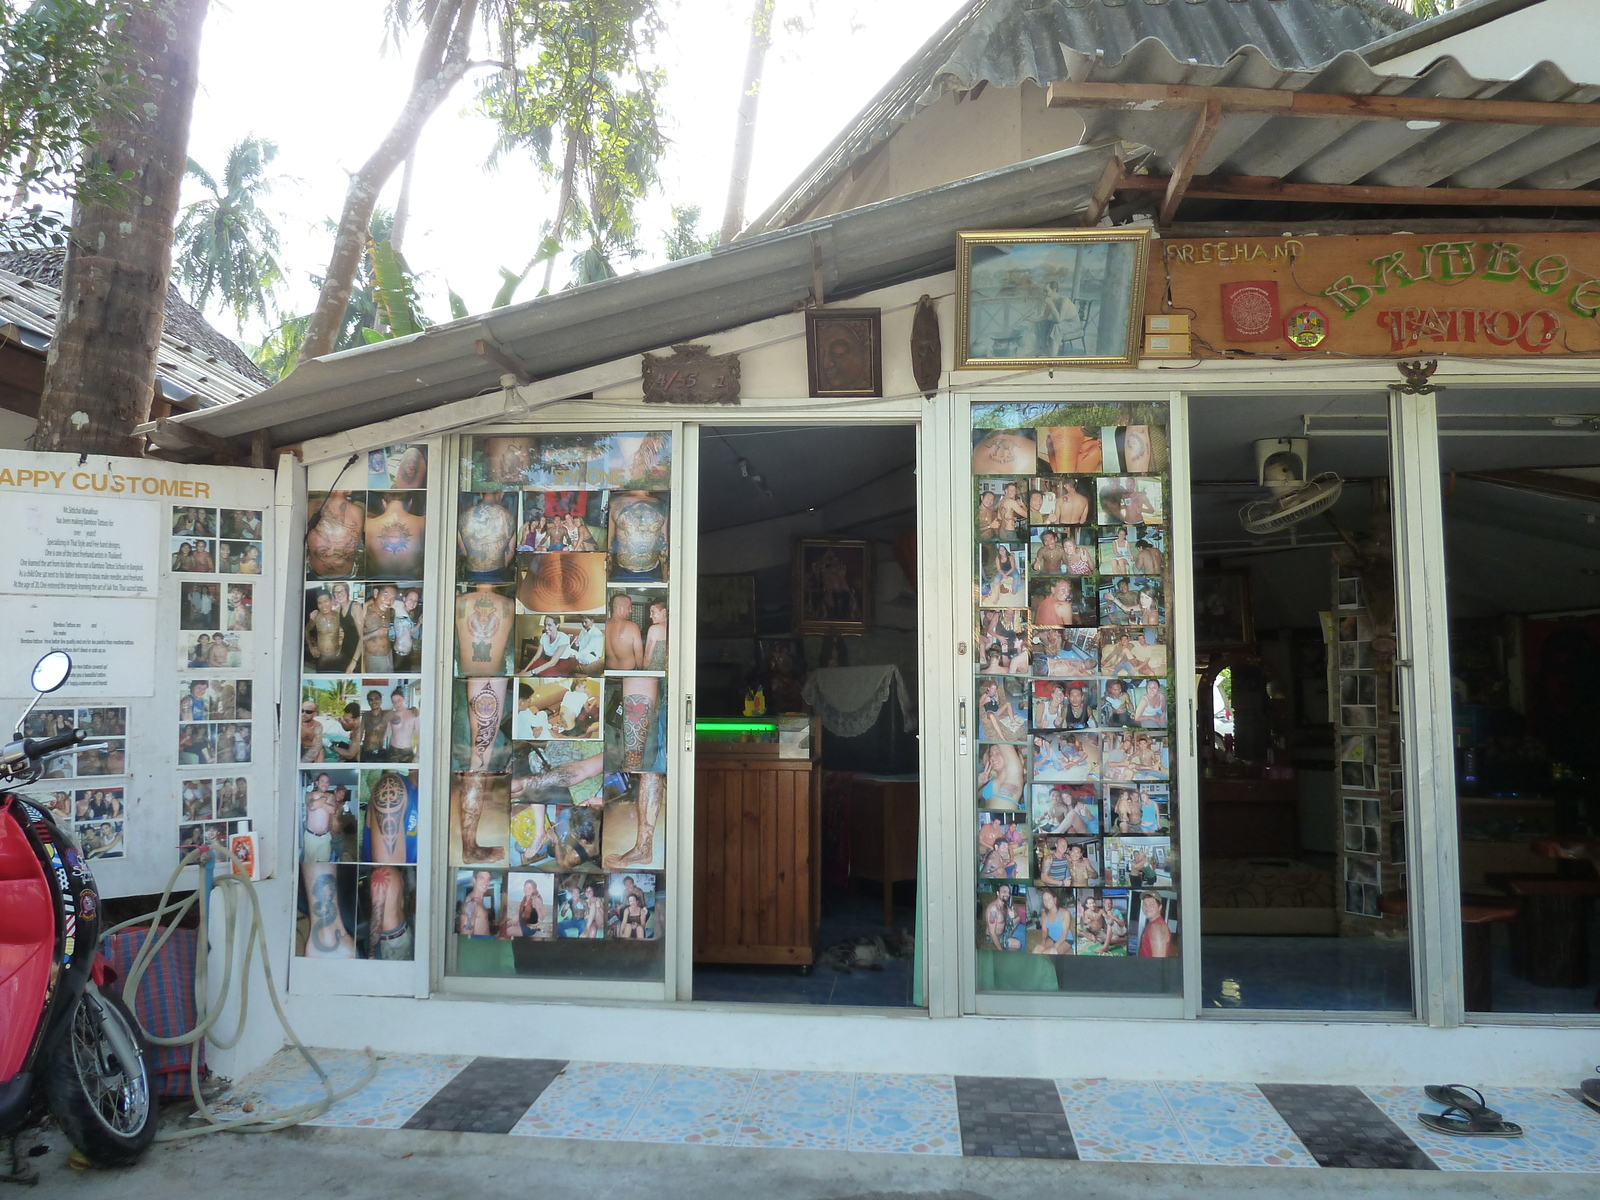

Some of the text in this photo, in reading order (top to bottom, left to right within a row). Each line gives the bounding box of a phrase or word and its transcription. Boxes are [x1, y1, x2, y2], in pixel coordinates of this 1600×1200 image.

[1376, 306, 1561, 352] TATTOO
[72, 472, 211, 499] CUSTOMER
[553, 469, 626, 486] BY ONE
